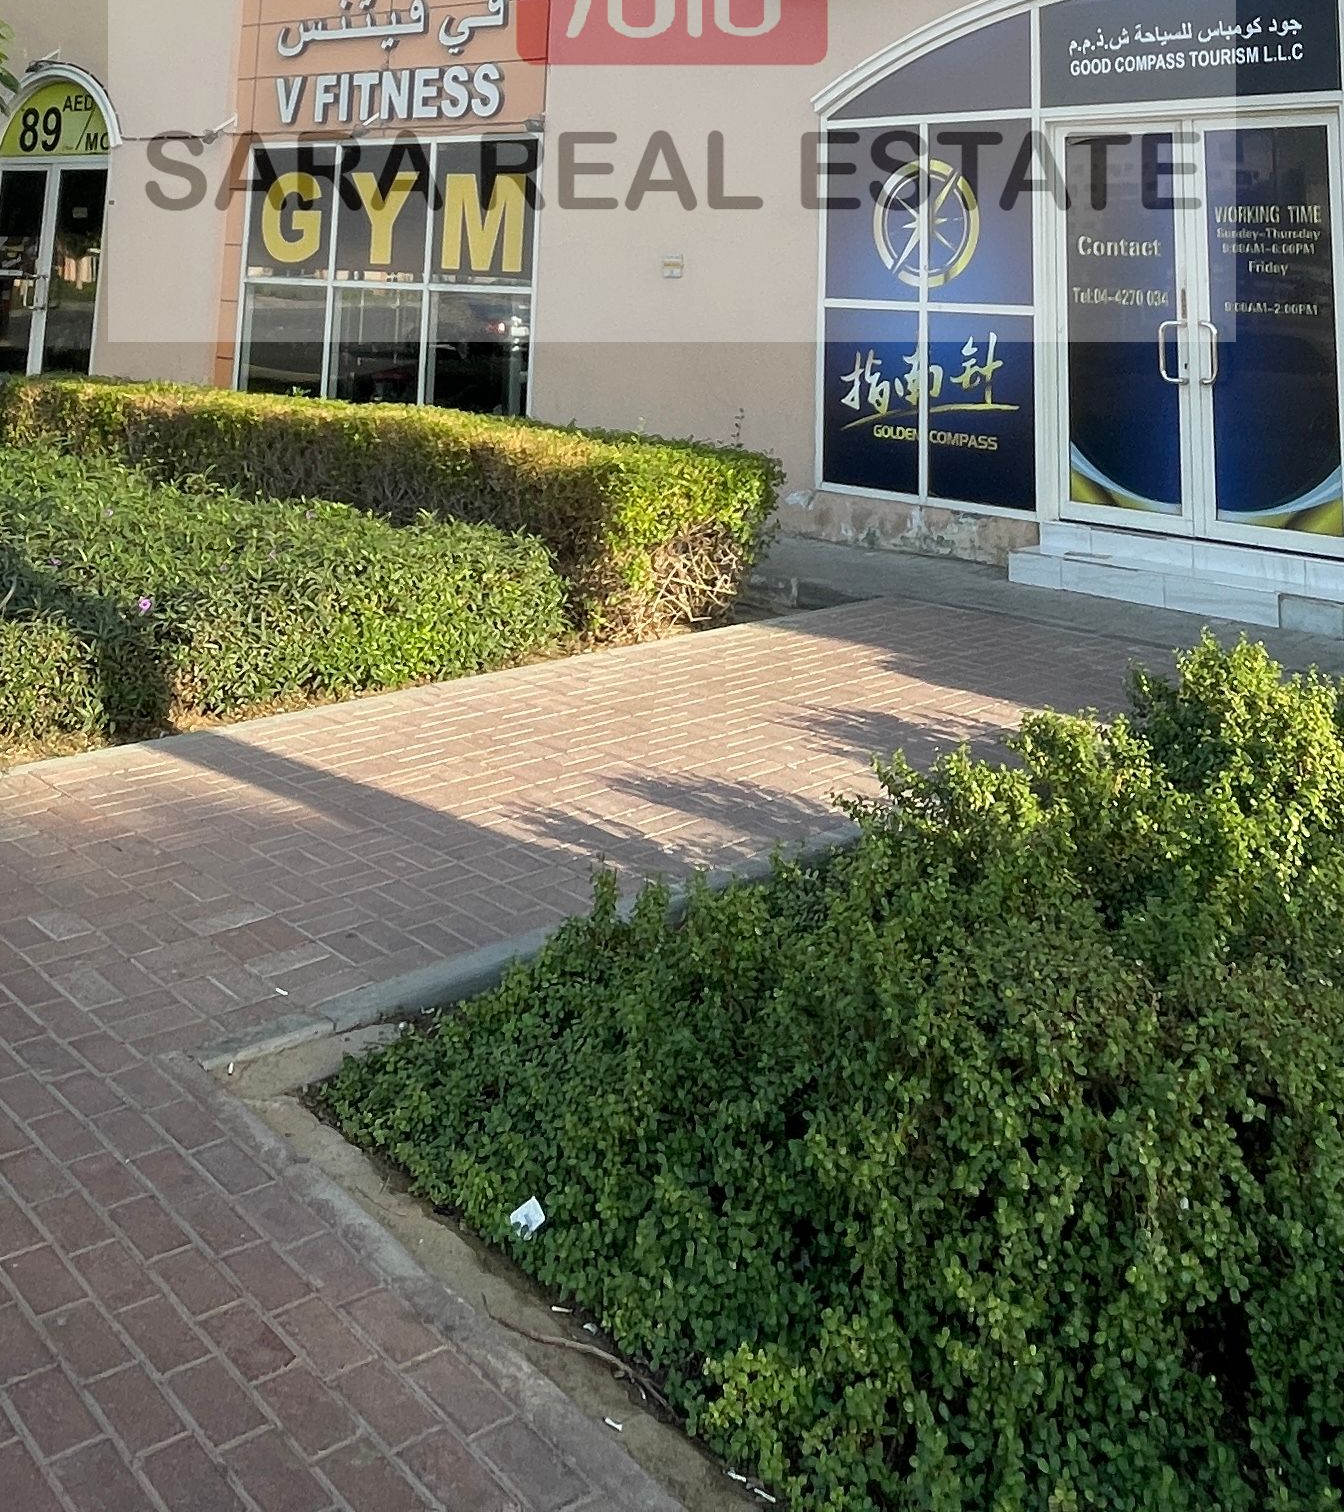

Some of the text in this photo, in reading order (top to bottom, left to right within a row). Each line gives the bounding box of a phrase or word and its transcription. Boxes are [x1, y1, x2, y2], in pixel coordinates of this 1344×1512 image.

[1134, 22, 1192, 46] للسياحة
[1268, 17, 1303, 34] جود
[1070, 43, 1304, 76] GOOD COMPASS TOURISM L.L.C
[276, 63, 502, 124] V FITNESS
[19, 94, 96, 153] 89 AED
[262, 171, 527, 272] GYM
[1214, 205, 1322, 224] WORKING TIME
[1077, 235, 1162, 258] Contact
[1248, 260, 1289, 276] Friday
[873, 424, 998, 451] GOLDEN COMPASS
